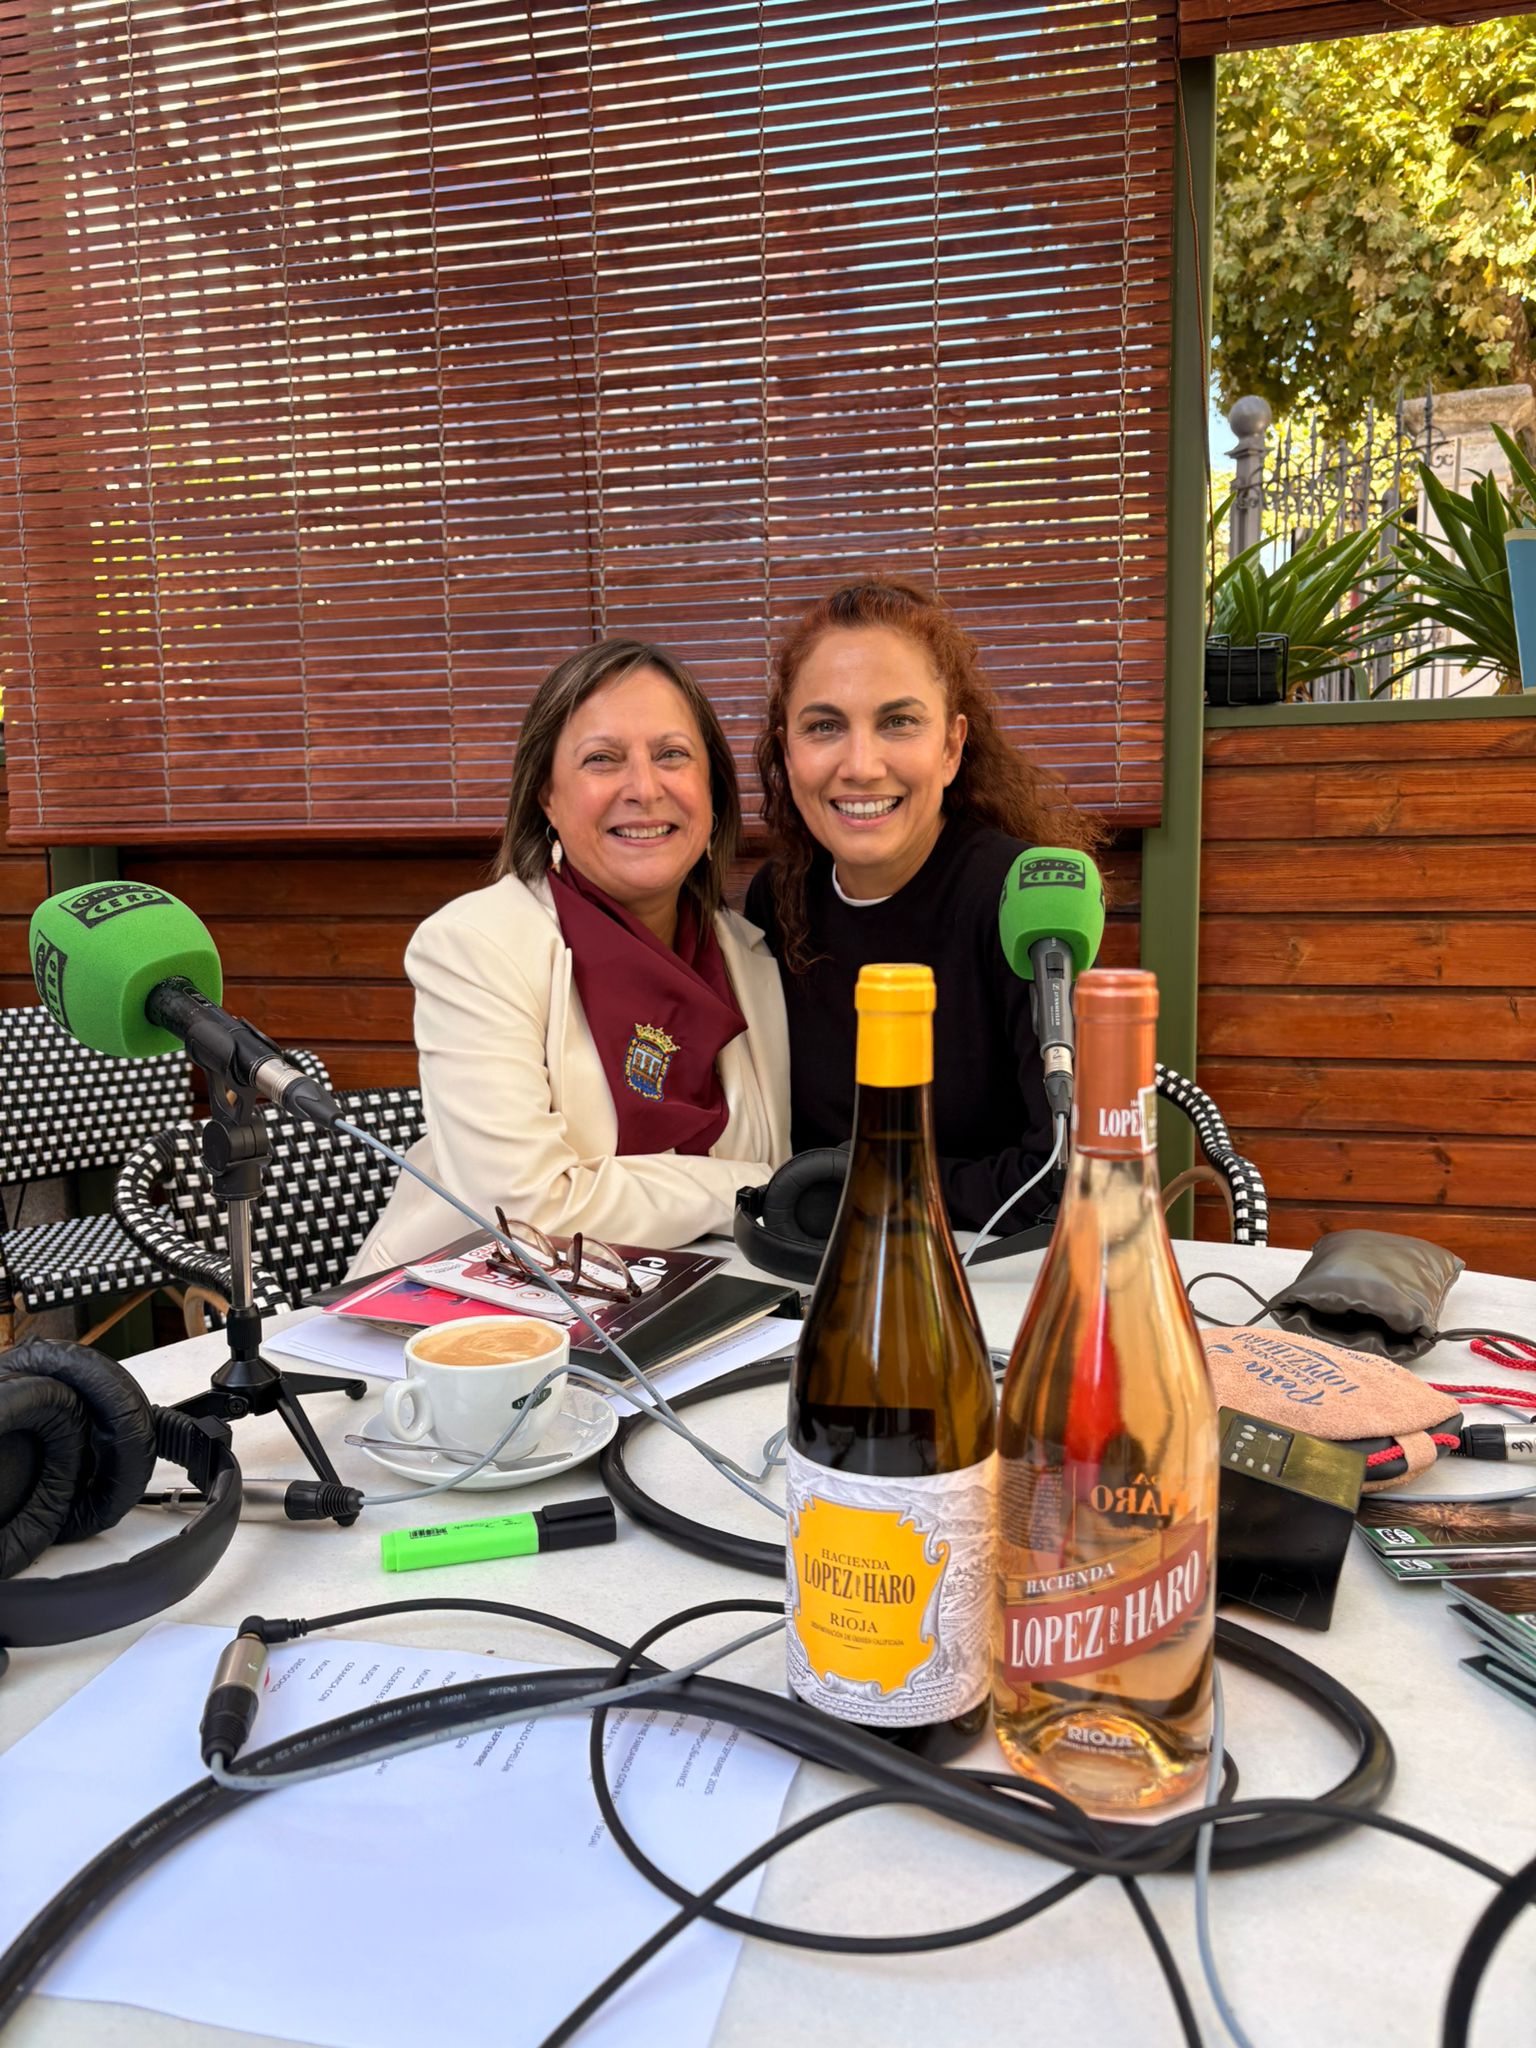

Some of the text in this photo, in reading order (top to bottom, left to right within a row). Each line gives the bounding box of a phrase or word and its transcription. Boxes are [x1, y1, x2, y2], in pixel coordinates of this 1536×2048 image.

[1029, 861, 1075, 869] ONDA
[1031, 872, 1076, 880] CERO
[77, 885, 142, 906] ONDA
[95, 893, 154, 913] CERO
[1243, 1360, 1325, 1406] Peña
[822, 1548, 891, 1571] HACIENDA
[804, 1552, 853, 1599] LOPEZ
[863, 1573, 916, 1605] HARO
[1026, 1562, 1116, 1595] HACIENDA
[1011, 1549, 1201, 1668] LOPEZ DE HARO
[830, 1612, 879, 1633] RIOJA
[1067, 1726, 1133, 1748] RIOJA
